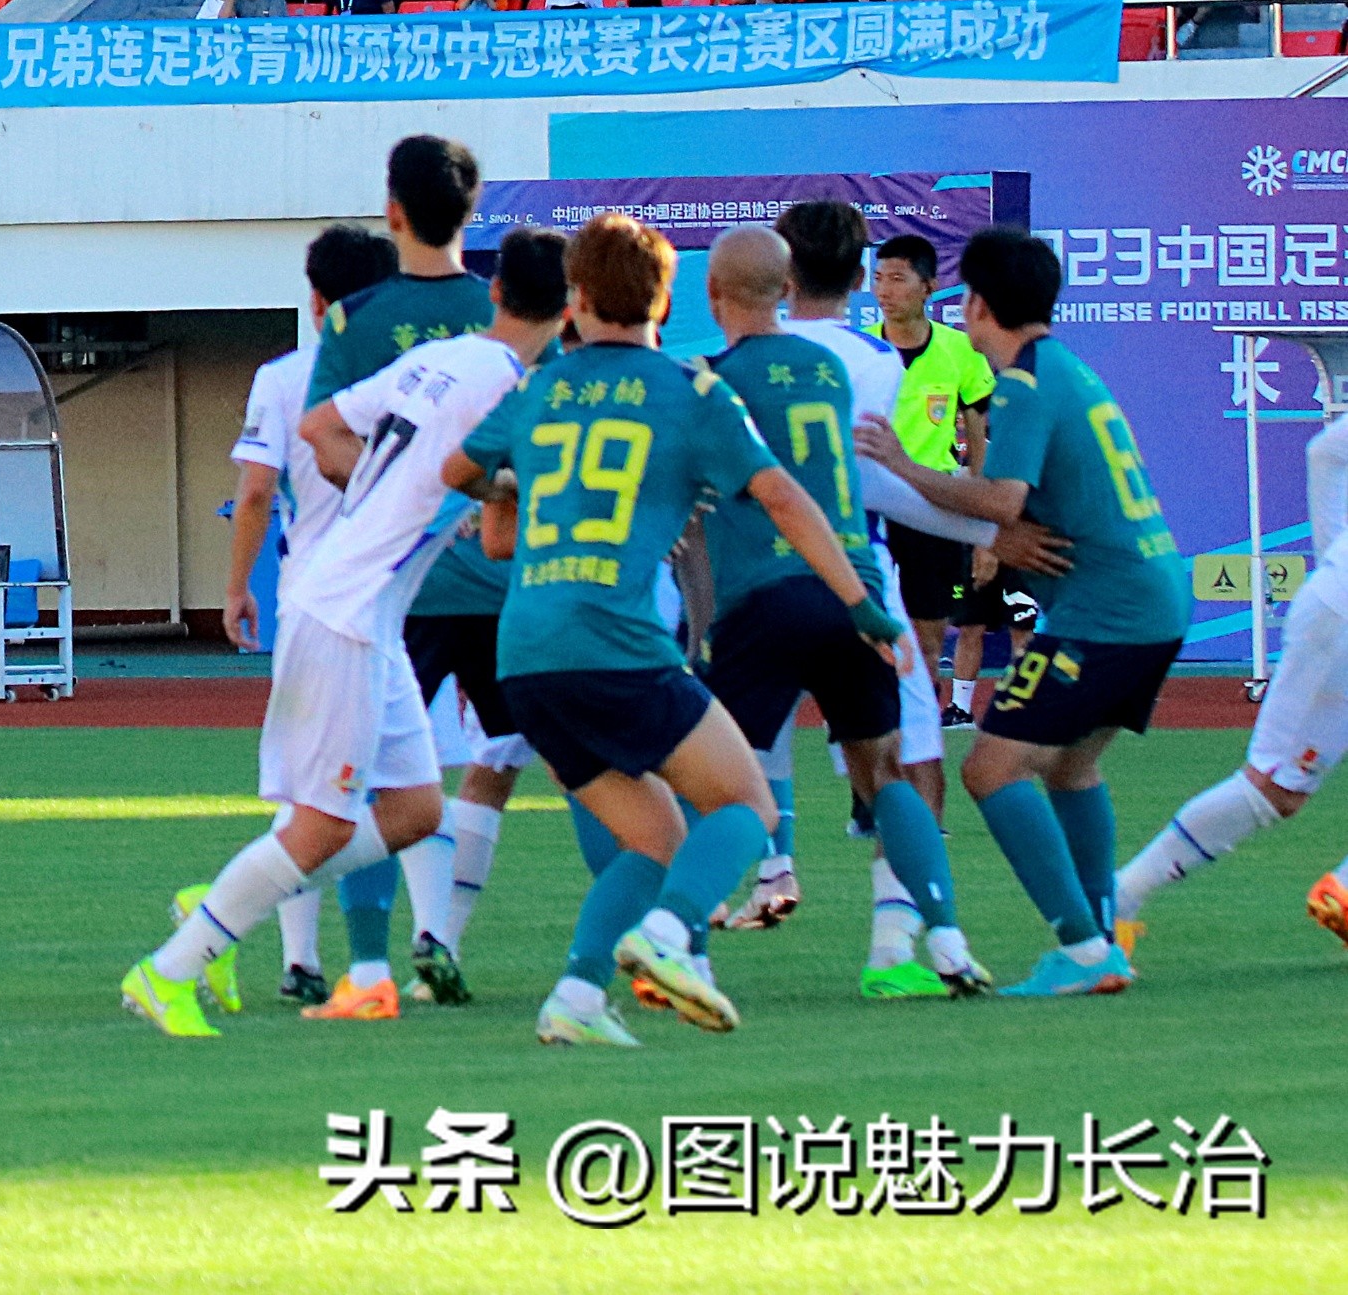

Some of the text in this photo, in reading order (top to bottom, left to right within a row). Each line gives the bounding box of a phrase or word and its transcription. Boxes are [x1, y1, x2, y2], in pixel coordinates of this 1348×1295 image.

[1291, 149, 1348, 174] CMC
[1160, 301, 1292, 322] FOOTBALL
[525, 417, 653, 550] 29
[786, 401, 852, 520] 7
